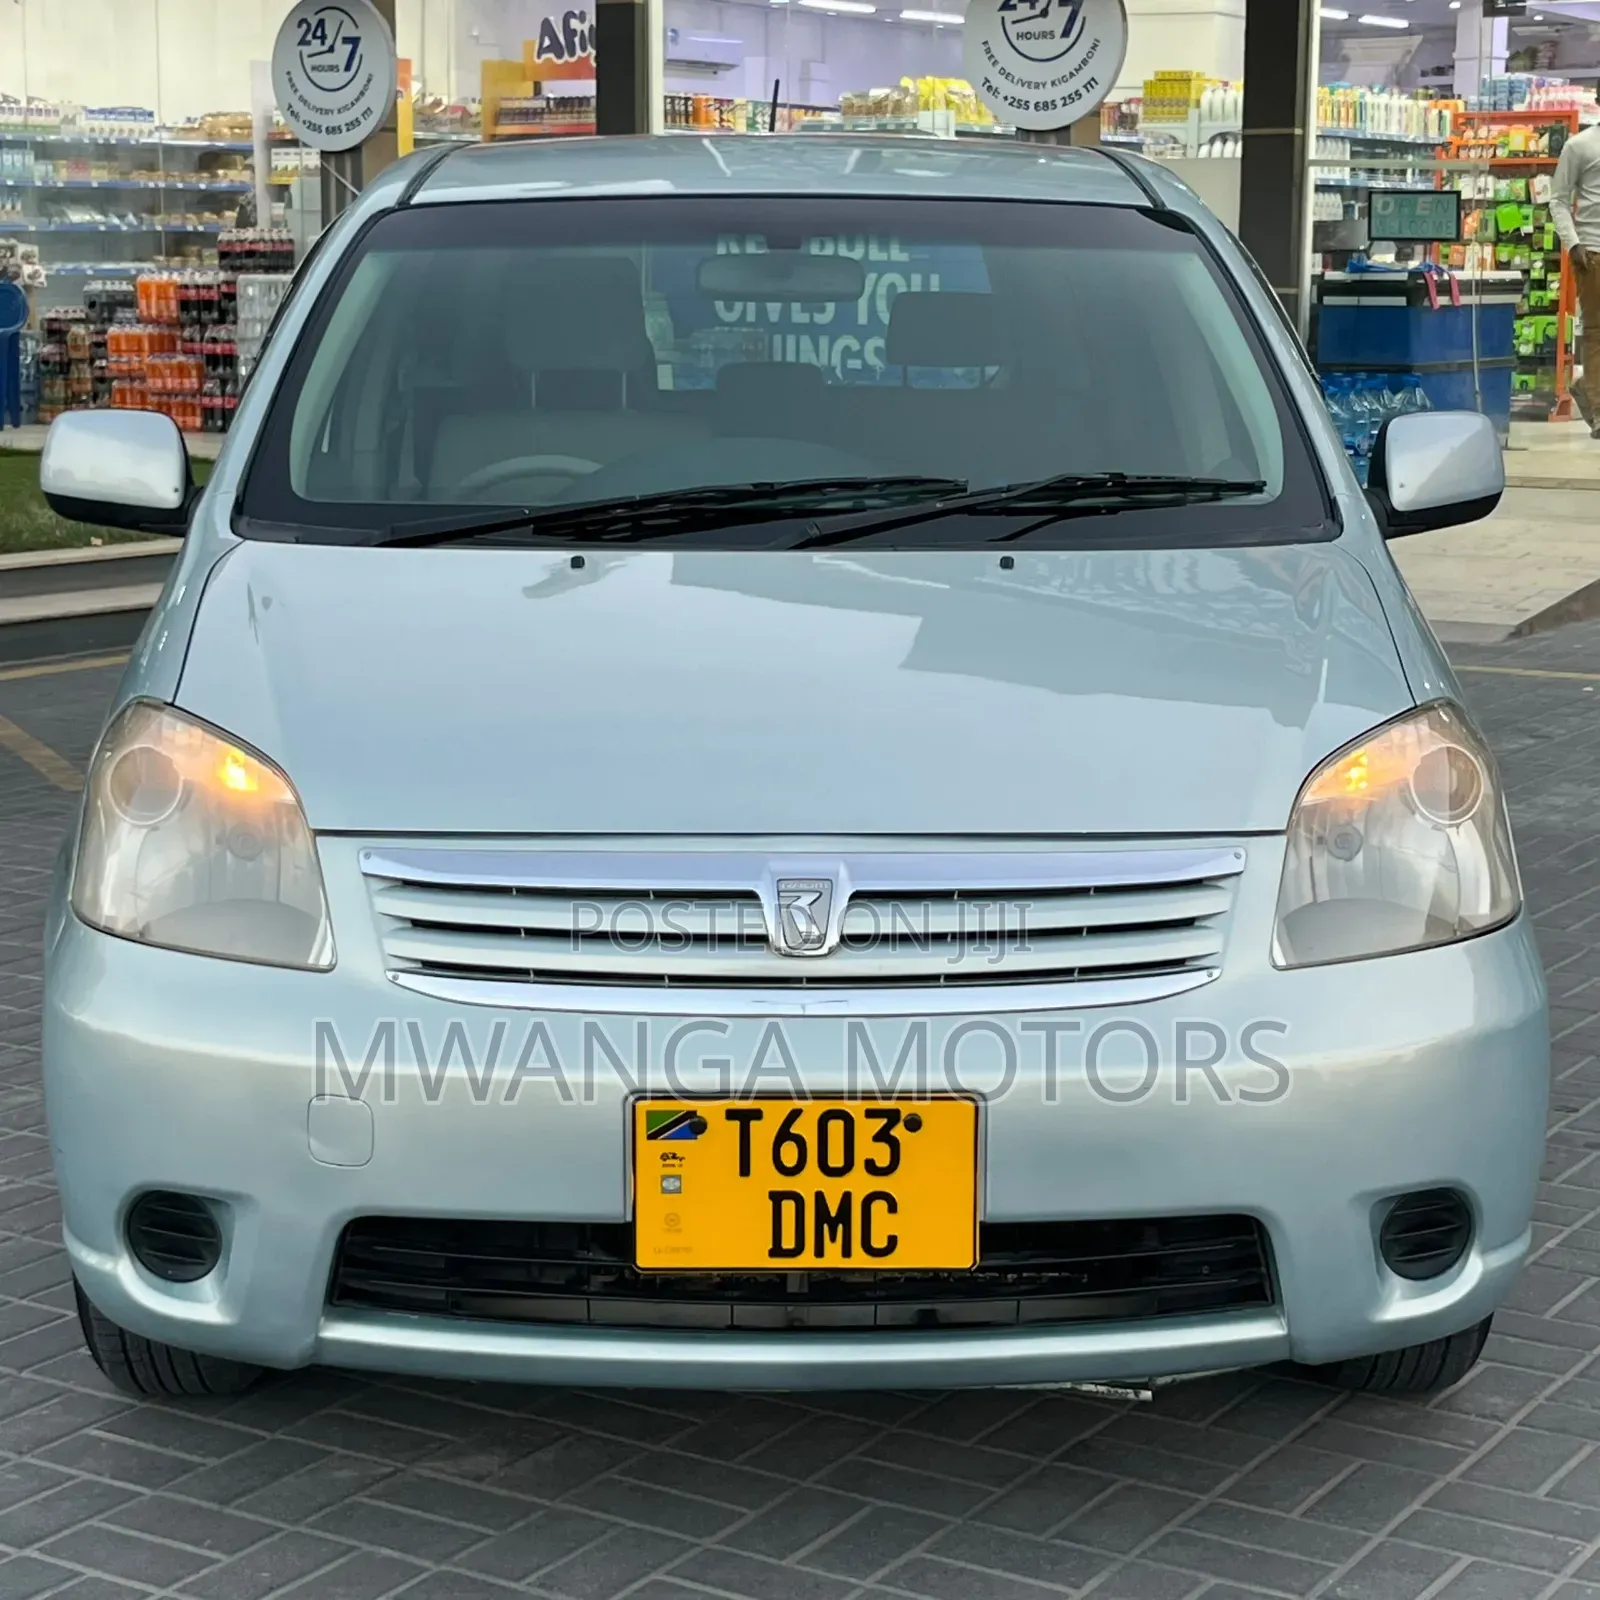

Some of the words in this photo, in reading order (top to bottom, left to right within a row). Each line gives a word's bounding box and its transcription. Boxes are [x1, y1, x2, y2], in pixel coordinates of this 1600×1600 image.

[1016, 31, 1055, 40] HOURS
[310, 64, 339, 73] HOURS
[982, 40, 999, 68] FREE
[998, 66, 1047, 90] DELIVERY
[1050, 38, 1101, 88] KIGAMBONI
[1003, 95, 1030, 111] +255
[1034, 100, 1057, 112] 685
[1060, 89, 1083, 108] 255
[325, 125, 343, 135] 685
[345, 116, 361, 133] 255
[1376, 196, 1451, 217] OPEN
[1375, 220, 1454, 237] WELCOME
[725, 1108, 901, 1177] T603
[768, 1190, 898, 1258] DMC
